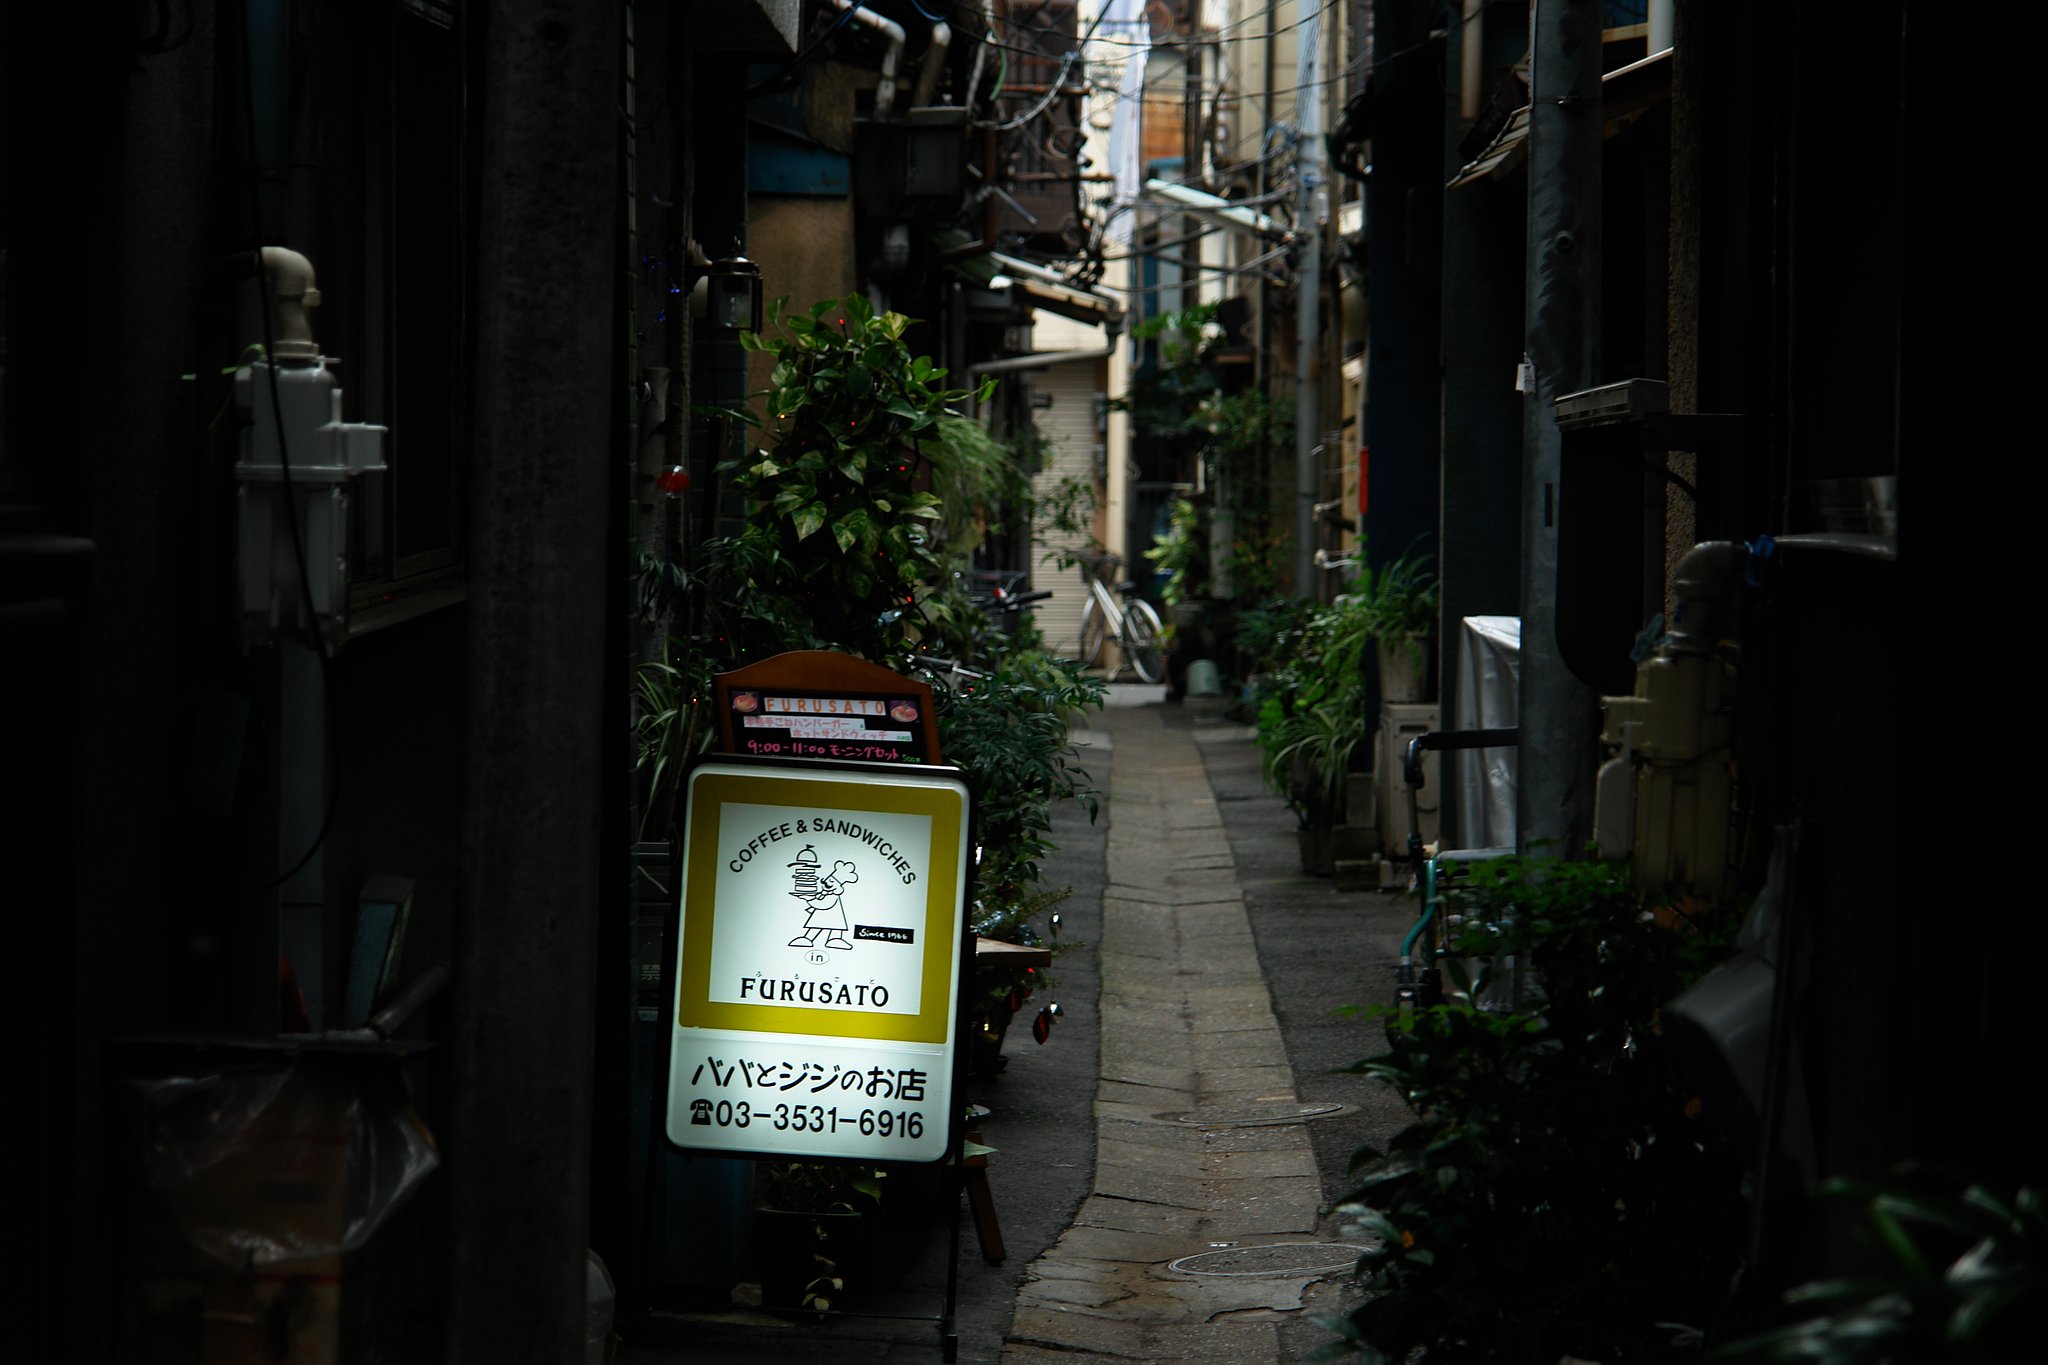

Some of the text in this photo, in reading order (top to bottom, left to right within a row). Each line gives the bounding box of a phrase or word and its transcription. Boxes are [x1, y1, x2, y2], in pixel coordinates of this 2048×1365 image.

[766, 698, 885, 715] FURUSATO
[829, 744, 900, 761] モーニングセット
[729, 817, 916, 885] COFFEE & SANDWICHES
[858, 928, 885, 939] Since
[810, 952, 824, 963] in
[740, 977, 889, 1008] FURUSATO
[691, 1056, 927, 1102] ババとジジのお店
[715, 1099, 925, 1140] 03-3531-6916
